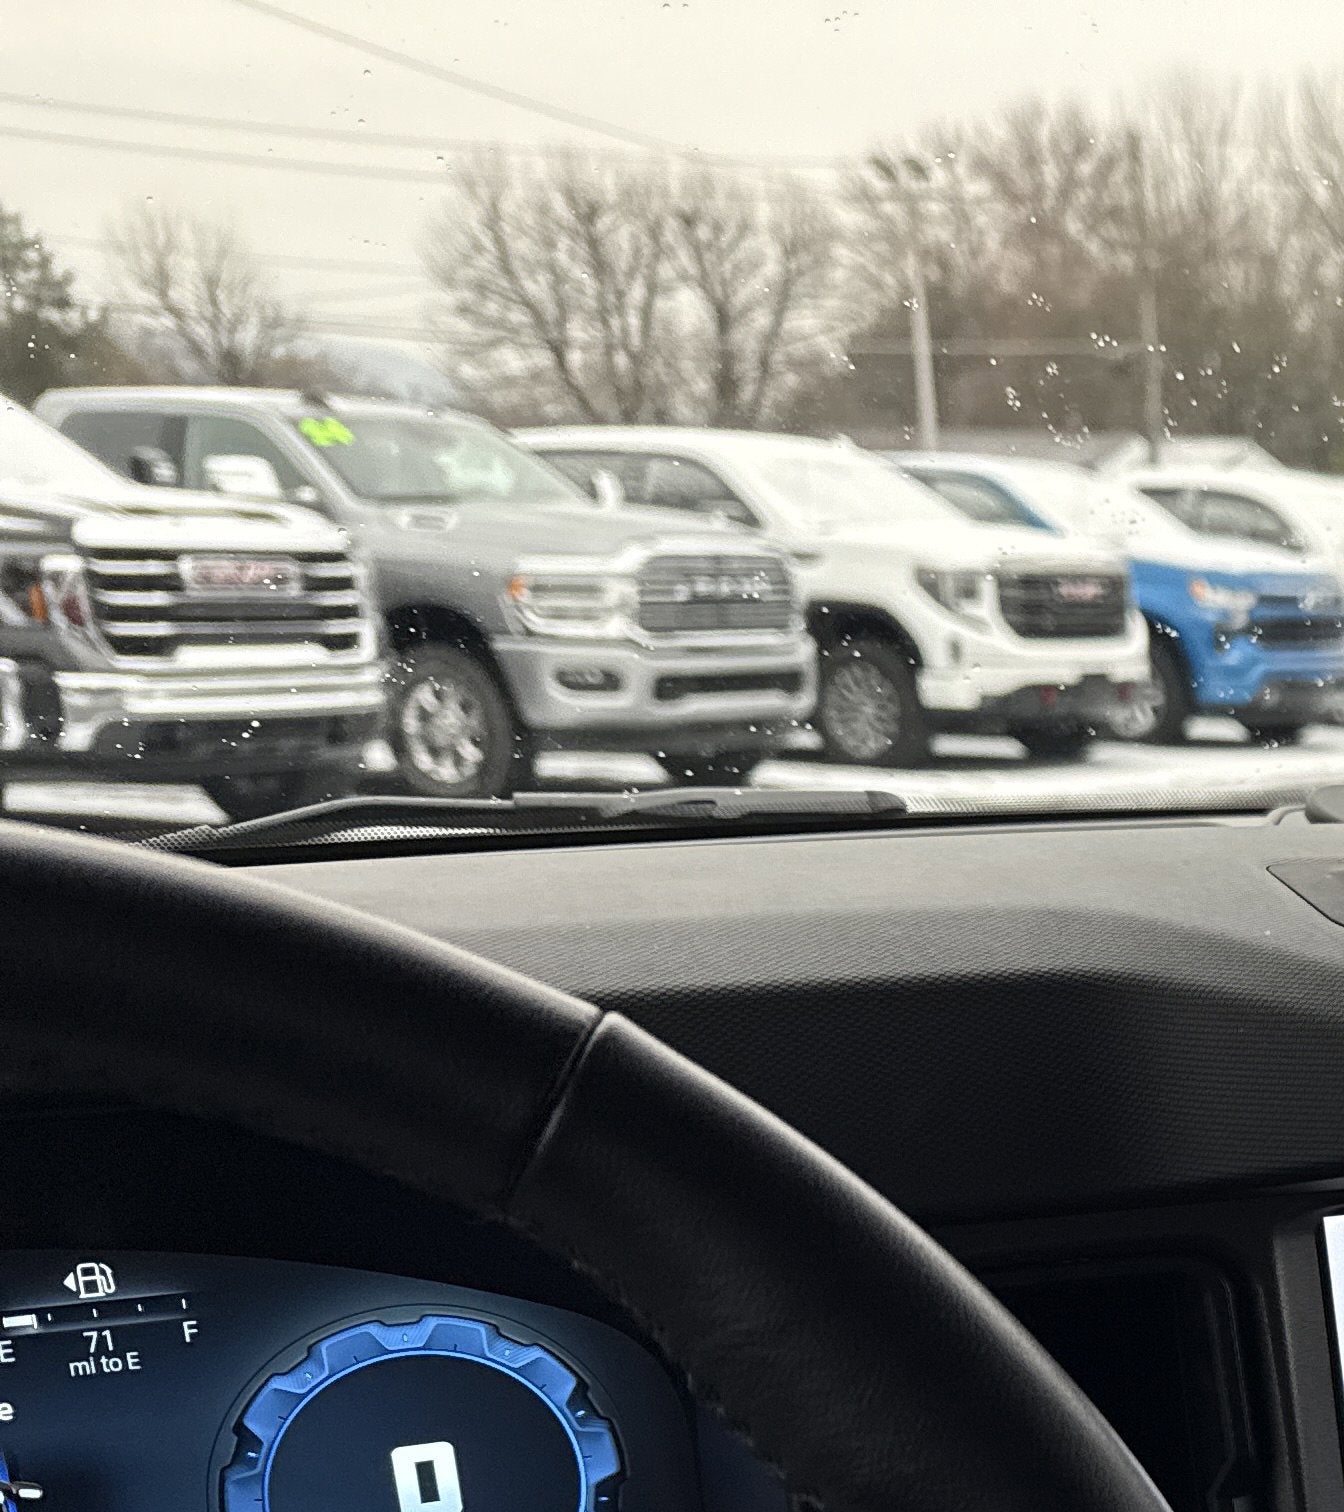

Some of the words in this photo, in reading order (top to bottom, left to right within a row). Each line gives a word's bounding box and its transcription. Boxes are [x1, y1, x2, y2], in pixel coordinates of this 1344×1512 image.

[83, 1329, 114, 1354] 71
[182, 1320, 199, 1343] F
[69, 1356, 96, 1377] mi
[100, 1355, 123, 1374] to
[126, 1351, 142, 1371] E
